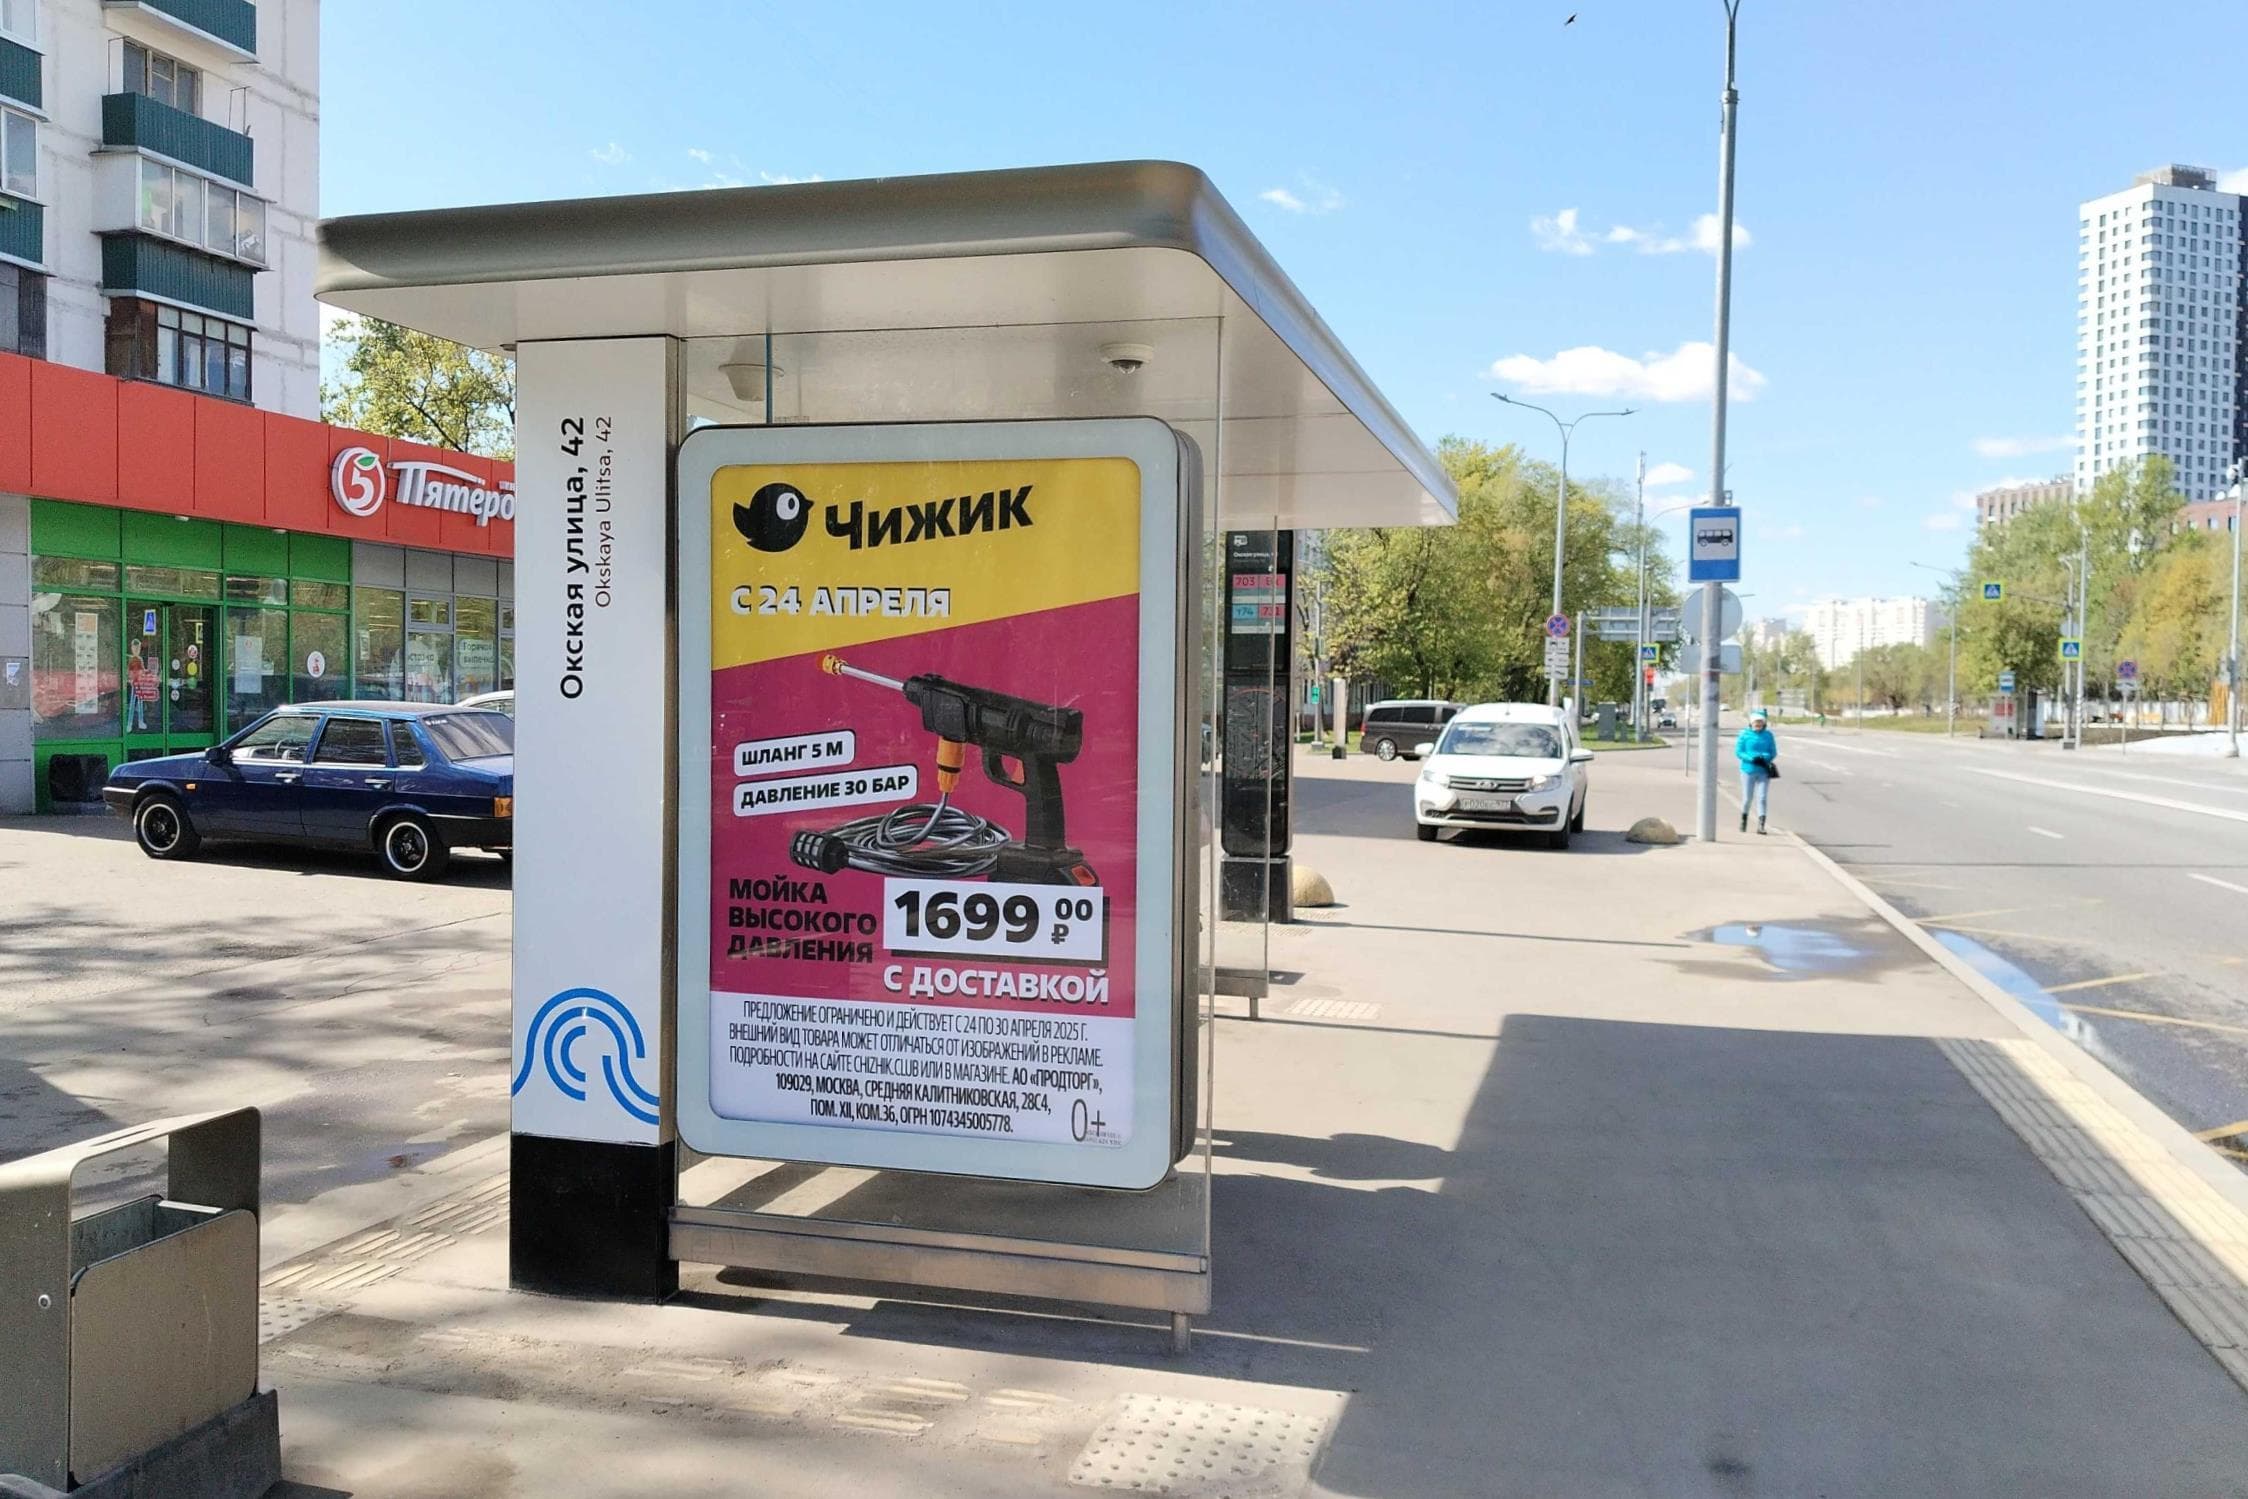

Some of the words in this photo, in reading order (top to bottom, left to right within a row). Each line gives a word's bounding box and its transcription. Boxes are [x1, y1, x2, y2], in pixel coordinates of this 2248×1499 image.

[561, 417, 584, 456] 42
[595, 416, 612, 442] 42
[595, 448, 614, 513] Ulitsa,
[566, 467, 589, 573] улица,
[595, 520, 615, 608] Okskaya
[731, 586, 751, 615] С
[758, 586, 802, 617] 24
[808, 587, 951, 618] АПРЕЛЯ
[560, 583, 584, 699] Окская
[741, 744, 808, 766] ШЛАНГ
[811, 743, 822, 759] 5
[826, 740, 843, 757] М
[740, 782, 841, 809] ДАВЛЕНИЕ
[844, 779, 868, 795] 30
[872, 775, 910, 793] БАР
[729, 874, 828, 904] МОЙКА
[728, 906, 877, 935] ВЫСОКОГО
[894, 890, 1040, 943] 1699
[1054, 898, 1093, 921] 00
[727, 934, 873, 963] ДАВЛЕНИЯ
[883, 965, 903, 992] С
[909, 968, 1110, 1004] ДОСТАВКОЙ
[743, 1000, 817, 1023] ПРЕДЛОЖЕНИЕ
[818, 1006, 884, 1028] ОГРАНИЧЕНО
[886, 1010, 894, 1028] И
[895, 1008, 954, 1032] ДЕЙСТВУЕТ
[955, 1015, 962, 1033] С
[965, 1016, 977, 1034] 24
[978, 1017, 994, 1035] ПО
[996, 1018, 1009, 1036] 30
[1010, 1019, 1052, 1039] АПРЕЛЯ
[1053, 1021, 1079, 1041] 2025
[1080, 1023, 1088, 1041] Г.
[729, 1022, 778, 1044] ВНЕШНИЙ
[779, 1027, 800, 1047] ВИД
[802, 1028, 840, 1048] ТОВАРА
[841, 1031, 879, 1051] МОЖЕТ
[881, 1033, 944, 1055] ОТЛИЧАТЬСЯ
[946, 1038, 960, 1056] ОТ
[961, 1039, 1040, 1062] ИЗОБРАЖЕНИЙ
[1042, 1044, 1049, 1063] В
[1051, 1045, 1103, 1067] РЕКЛАМЕ.
[729, 1045, 803, 1068] ПОДРОБНОСТИ
[804, 1051, 819, 1070] НА
[820, 1050, 852, 1072] САЙТЕ
[854, 1056, 919, 1077] CHIZHIK.CLUB
[920, 1060, 943, 1079] ИЛИ
[945, 1062, 951, 1080] В
[953, 1063, 1010, 1084] МАГАЗИНЕ.
[1012, 1067, 1028, 1086] АО
[1030, 1069, 1103, 1095] «ПРОДТОРГ»,
[776, 1073, 815, 1096] 109029,
[816, 1076, 863, 1100] МОСКВА,
[865, 1080, 913, 1102] СРЕДНЯЯ
[914, 1084, 1019, 1112] КАЛИТНИКОВСКАЯ,
[810, 1099, 838, 1117] ПОМ.
[856, 1103, 898, 1126] КОМ.36,
[900, 1106, 928, 1125] ОГРН
[929, 1109, 1014, 1133] 1074345005778.
[1071, 1098, 1106, 1142] 0+
